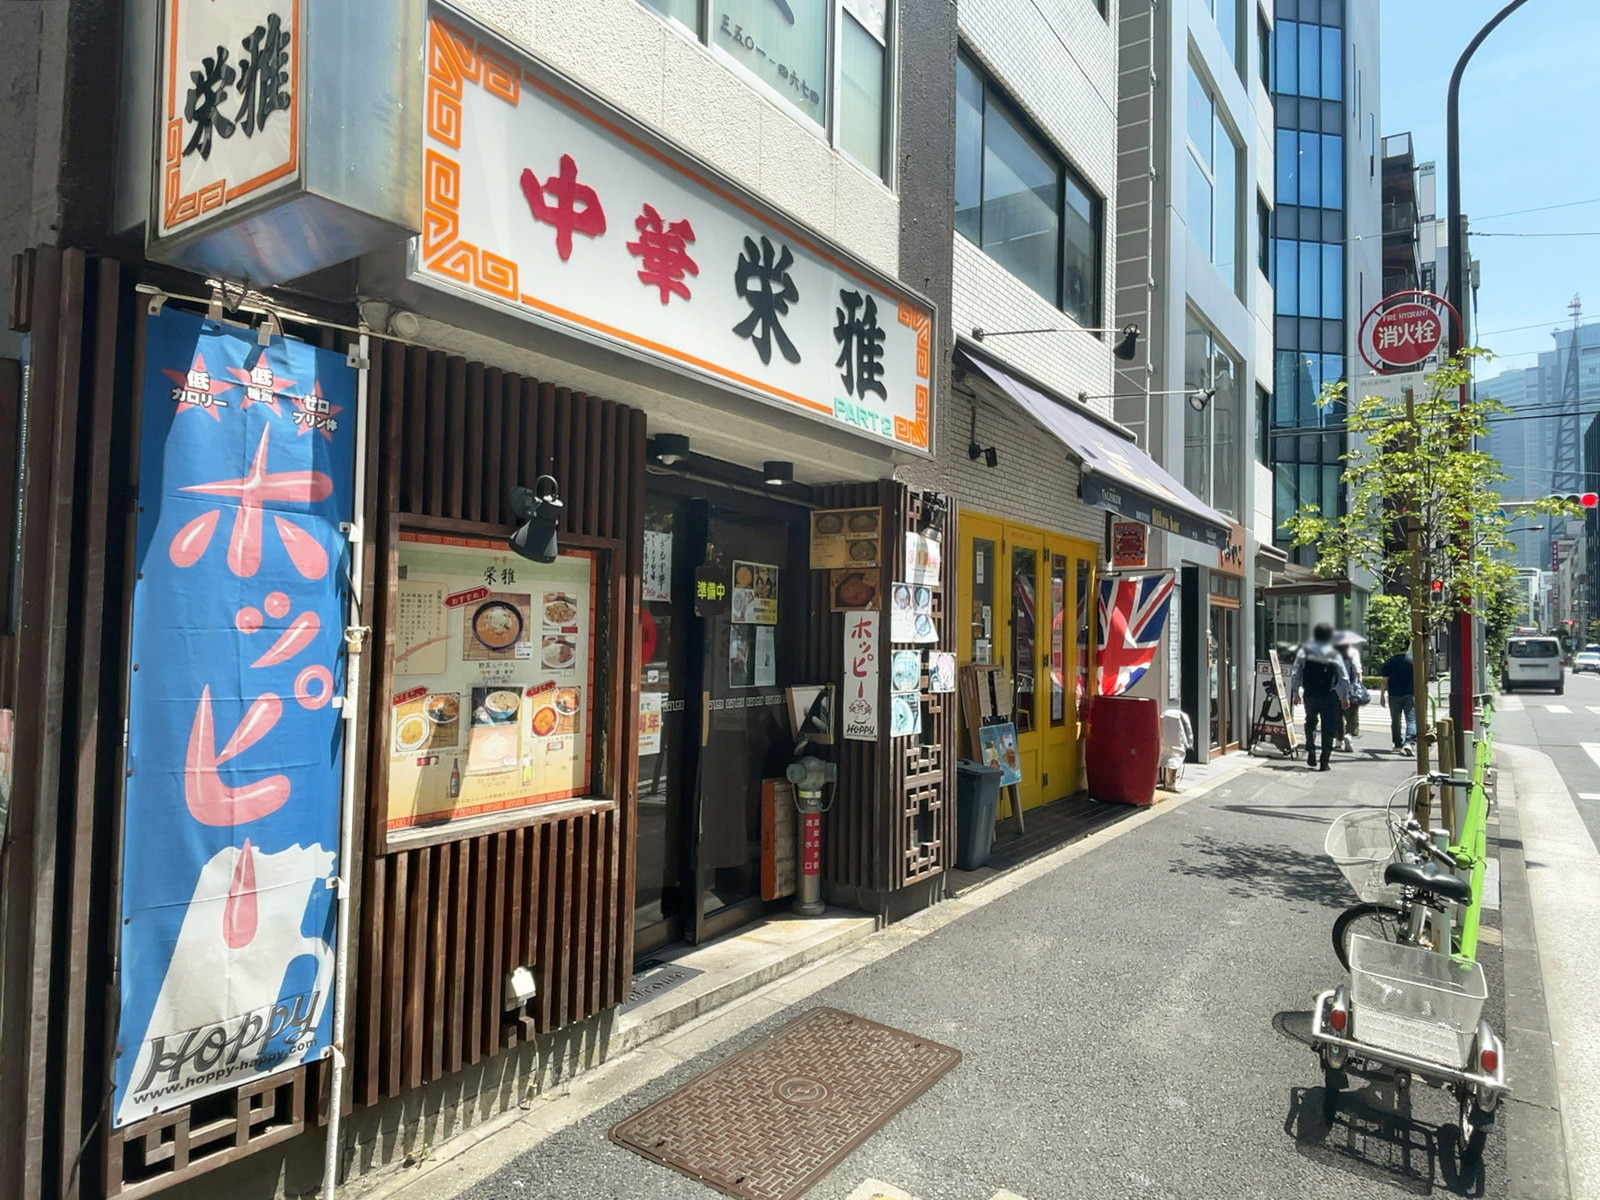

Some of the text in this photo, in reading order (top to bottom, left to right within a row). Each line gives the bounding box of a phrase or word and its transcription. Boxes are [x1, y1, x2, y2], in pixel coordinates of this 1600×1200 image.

[182, 13, 291, 162] 栄雅
[1382, 309, 1429, 323] FIRE HYDRANT
[1378, 319, 1437, 350] 消火栓
[187, 369, 211, 391] 低
[250, 366, 274, 388] 低
[172, 386, 229, 409] カロリー
[302, 394, 331, 415] ゼロ
[292, 410, 338, 432] プリン体
[834, 397, 893, 437] PART 2
[483, 566, 516, 586] 栄雅
[697, 580, 726, 601] 準備中
[850, 616, 875, 699] ホッピー
[169, 421, 334, 949] ホッピー
[134, 990, 321, 1094] Hoppy
[133, 1038, 318, 1106] www.hoppy-happy.com
